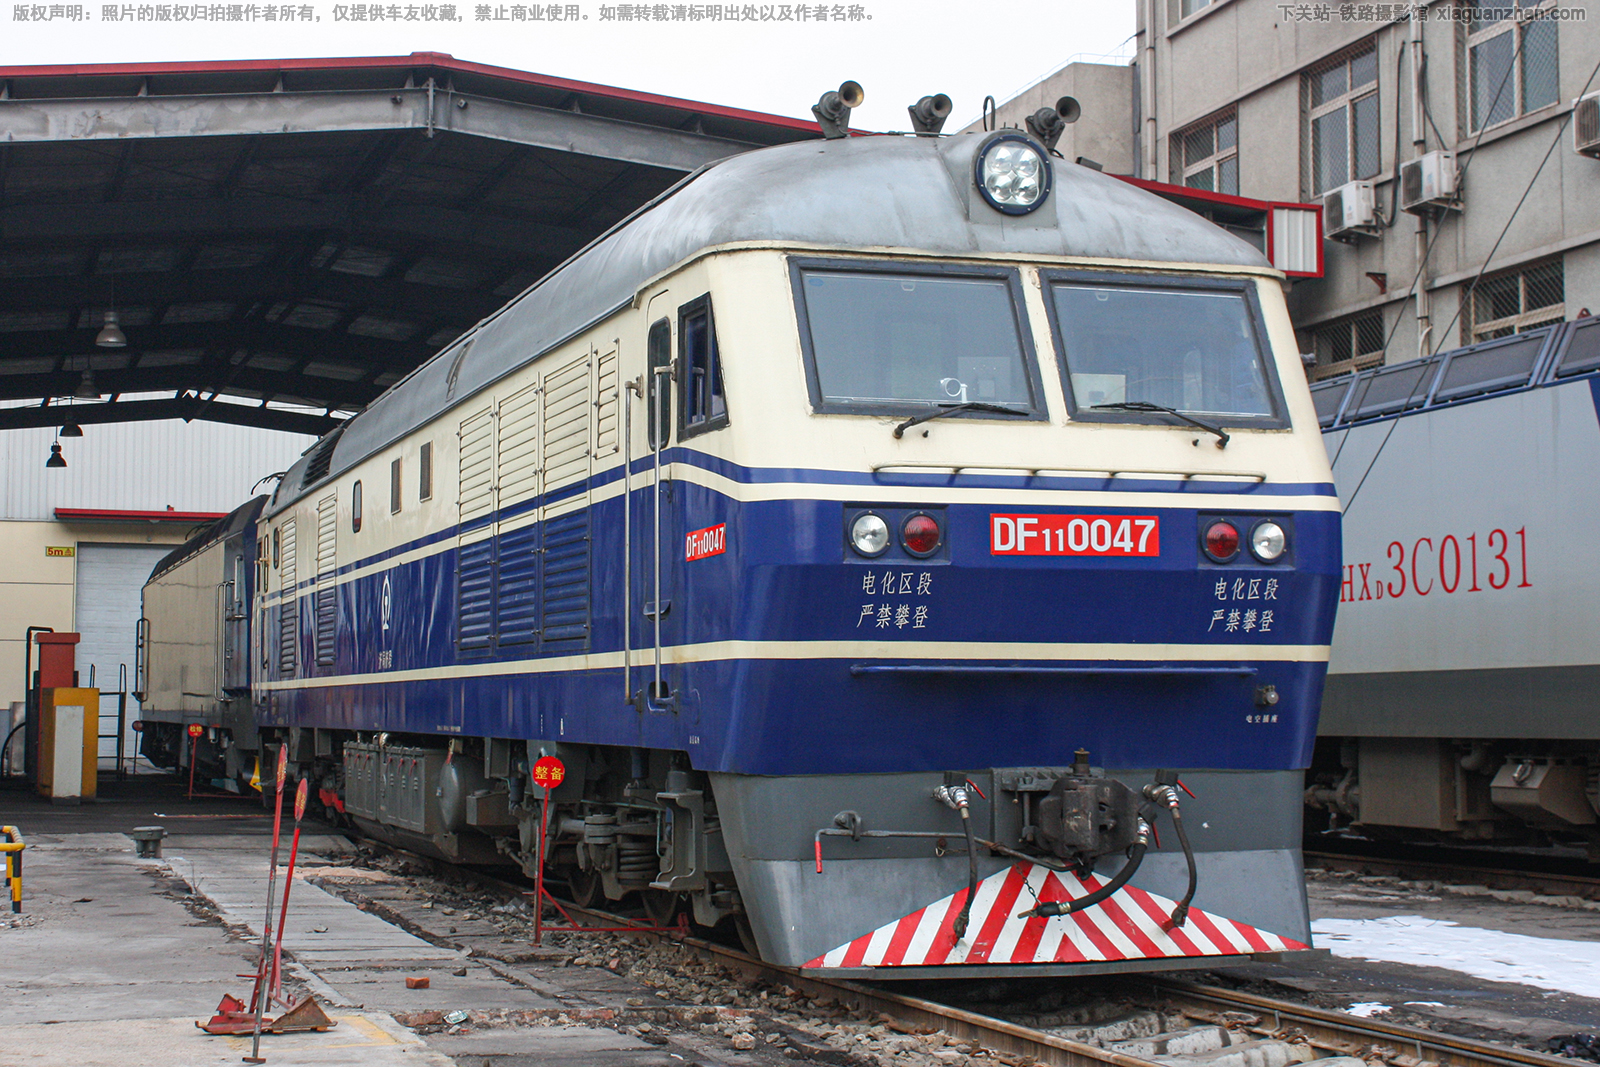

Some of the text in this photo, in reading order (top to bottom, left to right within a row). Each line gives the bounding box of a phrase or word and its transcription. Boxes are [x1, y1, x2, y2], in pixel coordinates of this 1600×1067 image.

[686, 526, 725, 558] DF110047
[993, 517, 1156, 553] DF110047
[47, 547, 64, 556] 5m
[862, 570, 933, 596] 电化区段
[1214, 577, 1279, 601] 电化区段
[856, 603, 929, 630] 严禁攀登
[1207, 608, 1274, 633] 严禁攀登
[535, 765, 565, 781] 整备
